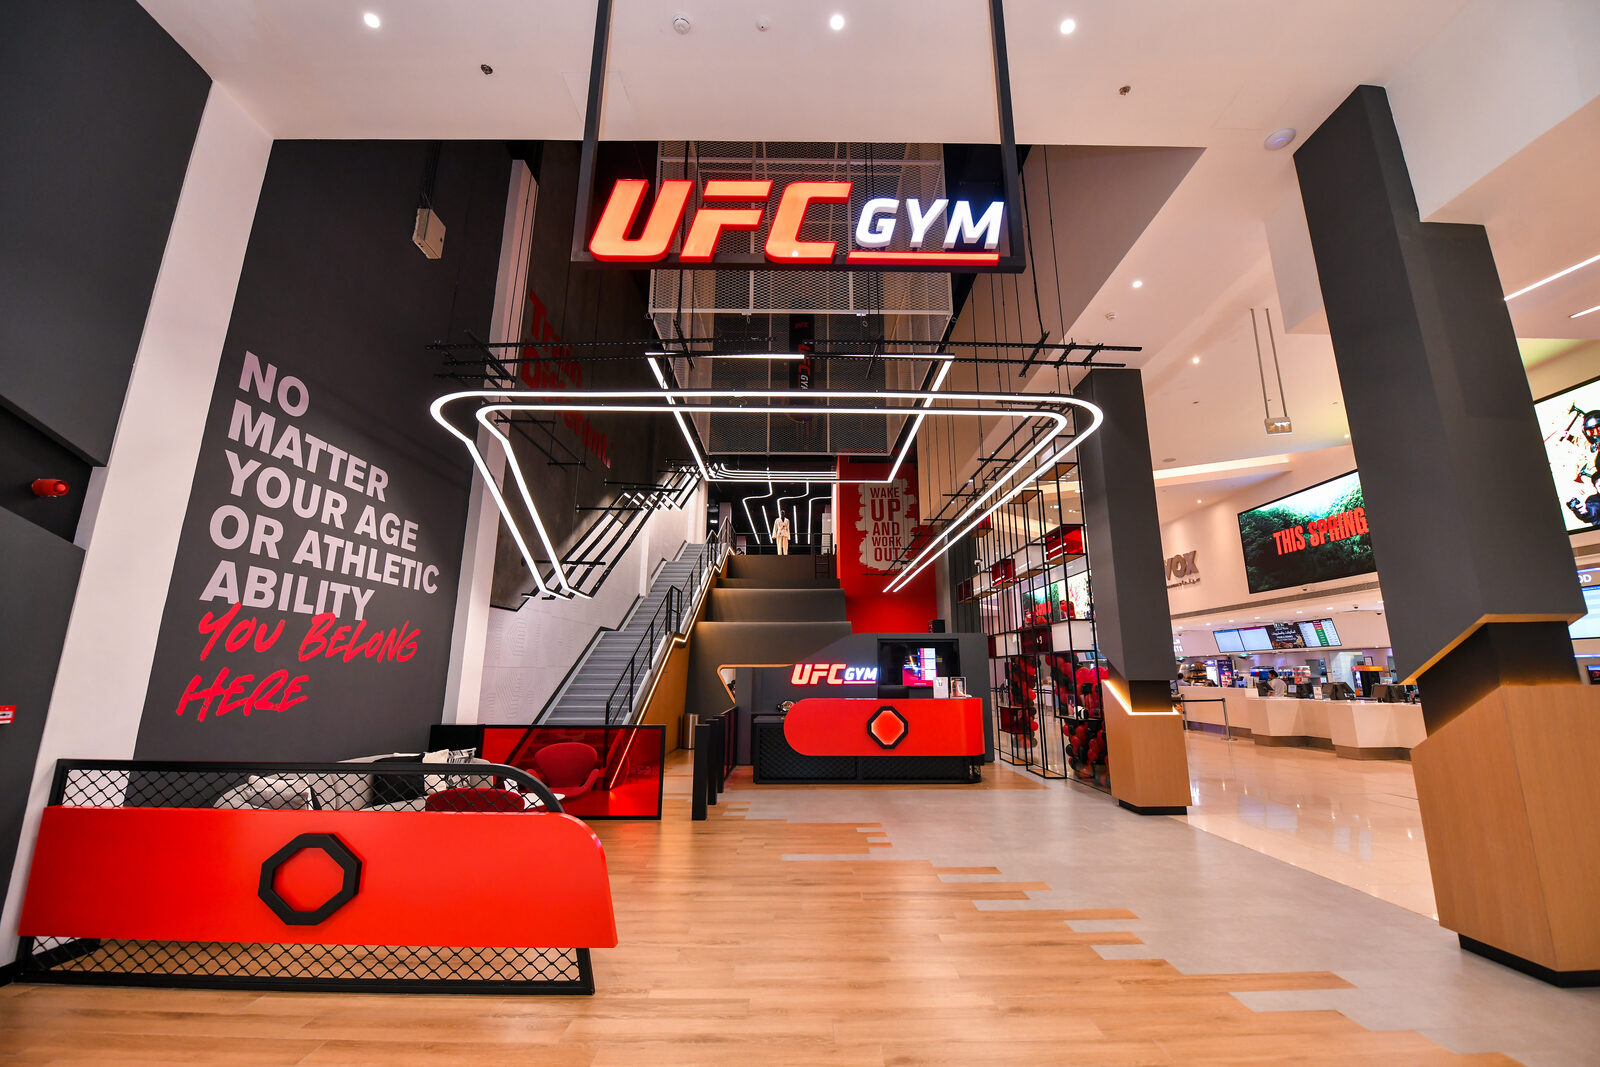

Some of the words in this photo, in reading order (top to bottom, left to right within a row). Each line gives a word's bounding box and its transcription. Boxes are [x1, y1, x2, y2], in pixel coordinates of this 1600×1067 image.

[588, 178, 854, 264] UFC
[855, 197, 1005, 250] GYM
[238, 350, 310, 417] NO
[227, 399, 389, 503] MATTER
[224, 449, 349, 530] YOUR
[354, 504, 419, 552] AGE
[870, 487, 900, 499] WAKE
[870, 498, 901, 521] UP
[209, 504, 284, 560] OR
[292, 529, 440, 594] ATHLETIC
[872, 522, 900, 536] AND
[872, 536, 902, 547] WORK
[874, 547, 901, 562] OUT
[1272, 525, 1306, 556] THIS
[1308, 506, 1369, 547] SPRING
[199, 559, 375, 621] ABILITY
[198, 601, 286, 661] YOU
[298, 612, 421, 663] BELONG
[175, 667, 310, 722] HERE
[790, 662, 847, 686] UFC
[844, 667, 878, 681] GYM
